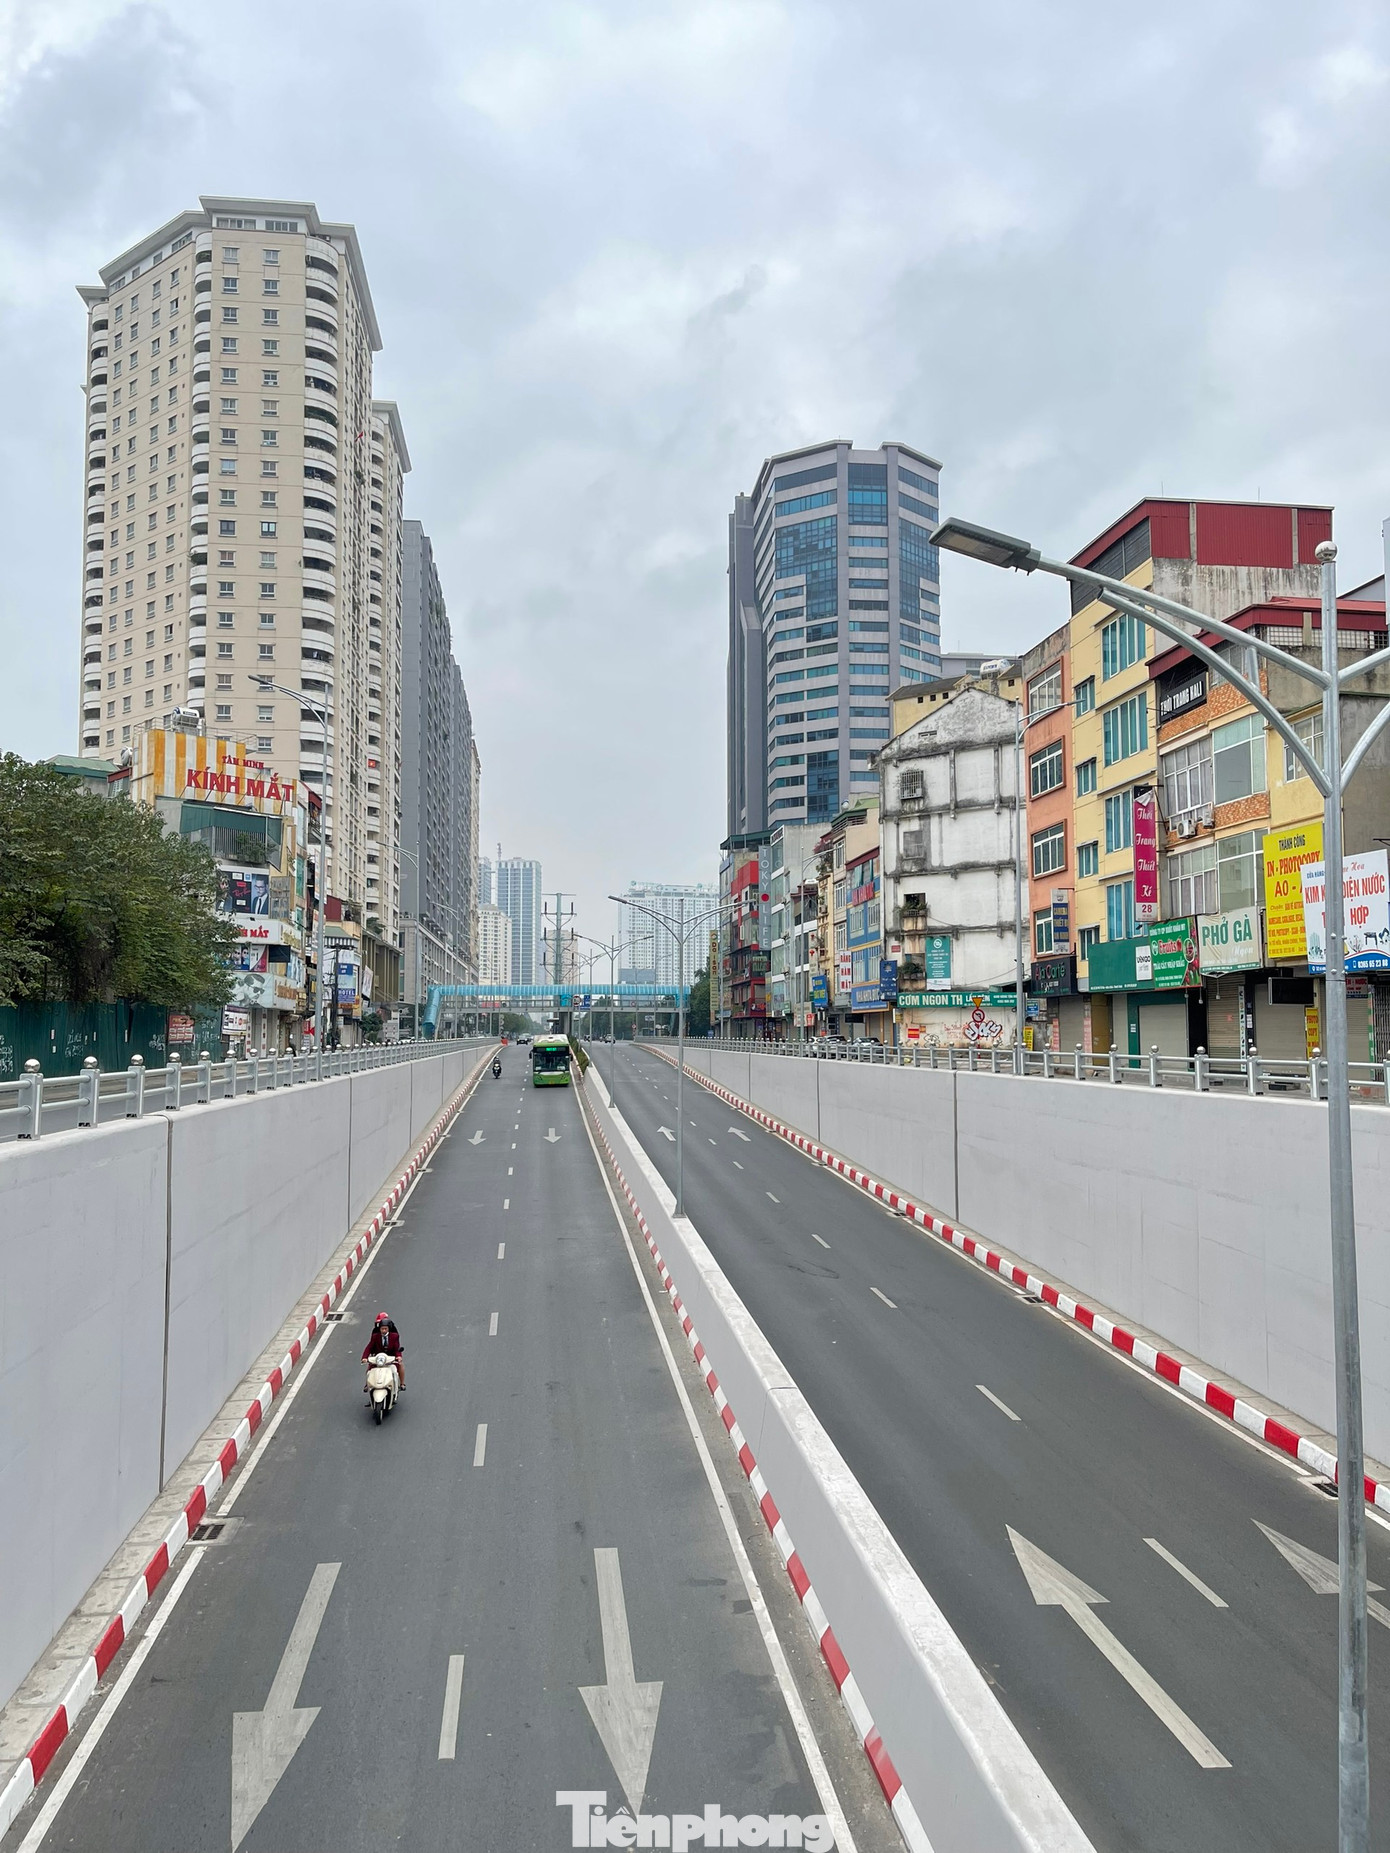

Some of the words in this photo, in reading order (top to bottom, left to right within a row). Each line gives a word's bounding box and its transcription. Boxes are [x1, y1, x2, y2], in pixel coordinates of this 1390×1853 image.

[187, 766, 240, 795] KÍNH
[247, 772, 295, 802] MẮT
[1304, 885, 1320, 904] KIM
[1361, 872, 1385, 897] NƯỚC
[1141, 903, 1153, 914] 28
[1350, 904, 1369, 929] HỢP
[249, 925, 269, 939] MẮT
[1201, 916, 1229, 947] PHỞ
[1233, 914, 1253, 943] GÀ
[898, 993, 920, 1006] CƠM
[922, 994, 949, 1006] NGON
[950, 994, 963, 1006] TH
